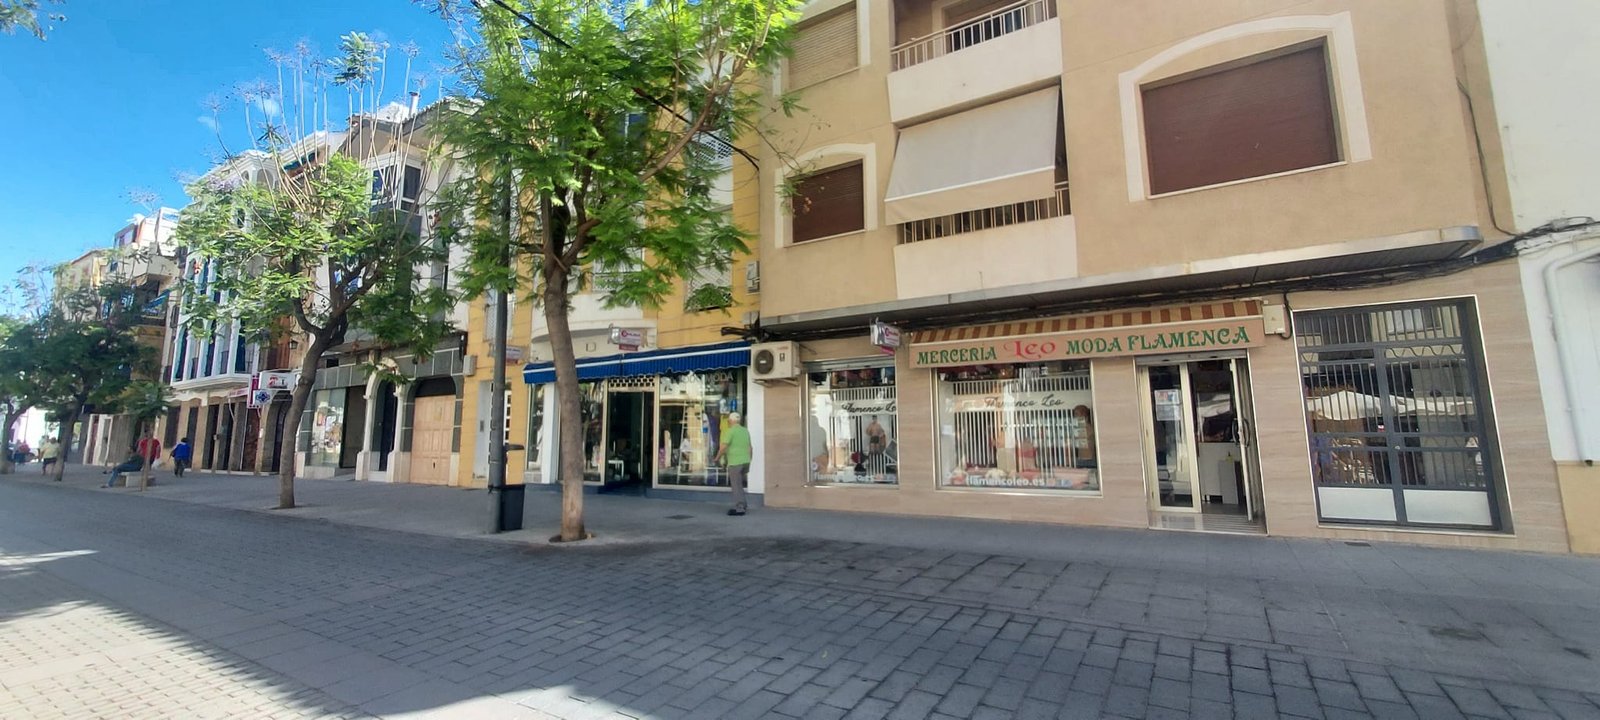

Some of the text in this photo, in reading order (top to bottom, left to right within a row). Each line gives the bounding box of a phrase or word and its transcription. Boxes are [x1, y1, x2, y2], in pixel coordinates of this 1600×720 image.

[1004, 341, 1055, 360] Leo
[1066, 337, 1122, 354] MODA
[1127, 327, 1250, 350] FLAMENCA
[1041, 393, 1065, 407] Leo
